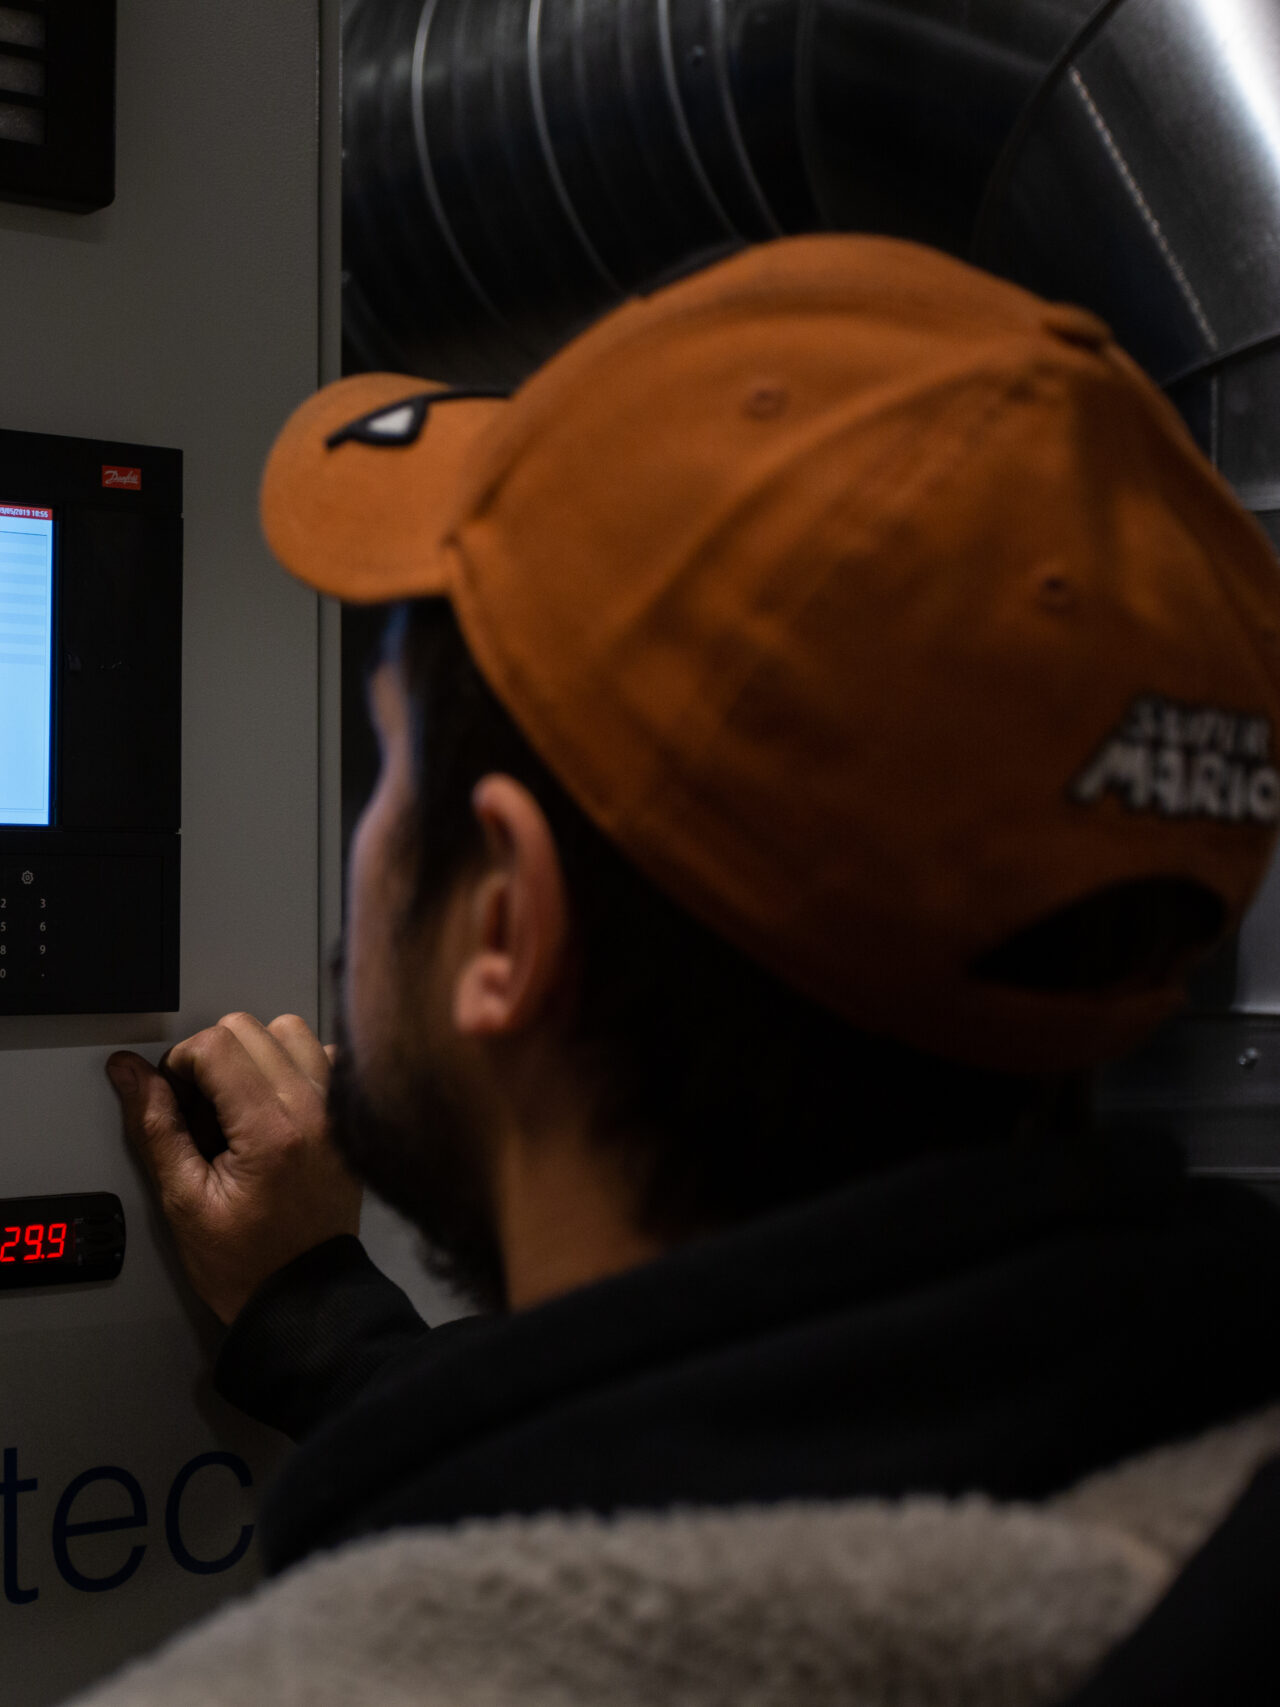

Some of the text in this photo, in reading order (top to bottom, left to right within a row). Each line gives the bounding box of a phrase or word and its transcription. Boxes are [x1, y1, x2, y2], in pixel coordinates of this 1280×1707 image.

[1077, 740, 1280, 820] MARIO
[0, 898, 7, 909] 2
[40, 898, 46, 909] 3
[0, 921, 7, 932] 5
[39, 921, 46, 932] 6
[0, 945, 7, 955] 8
[39, 945, 46, 955] 9
[0, 968, 7, 979] 0
